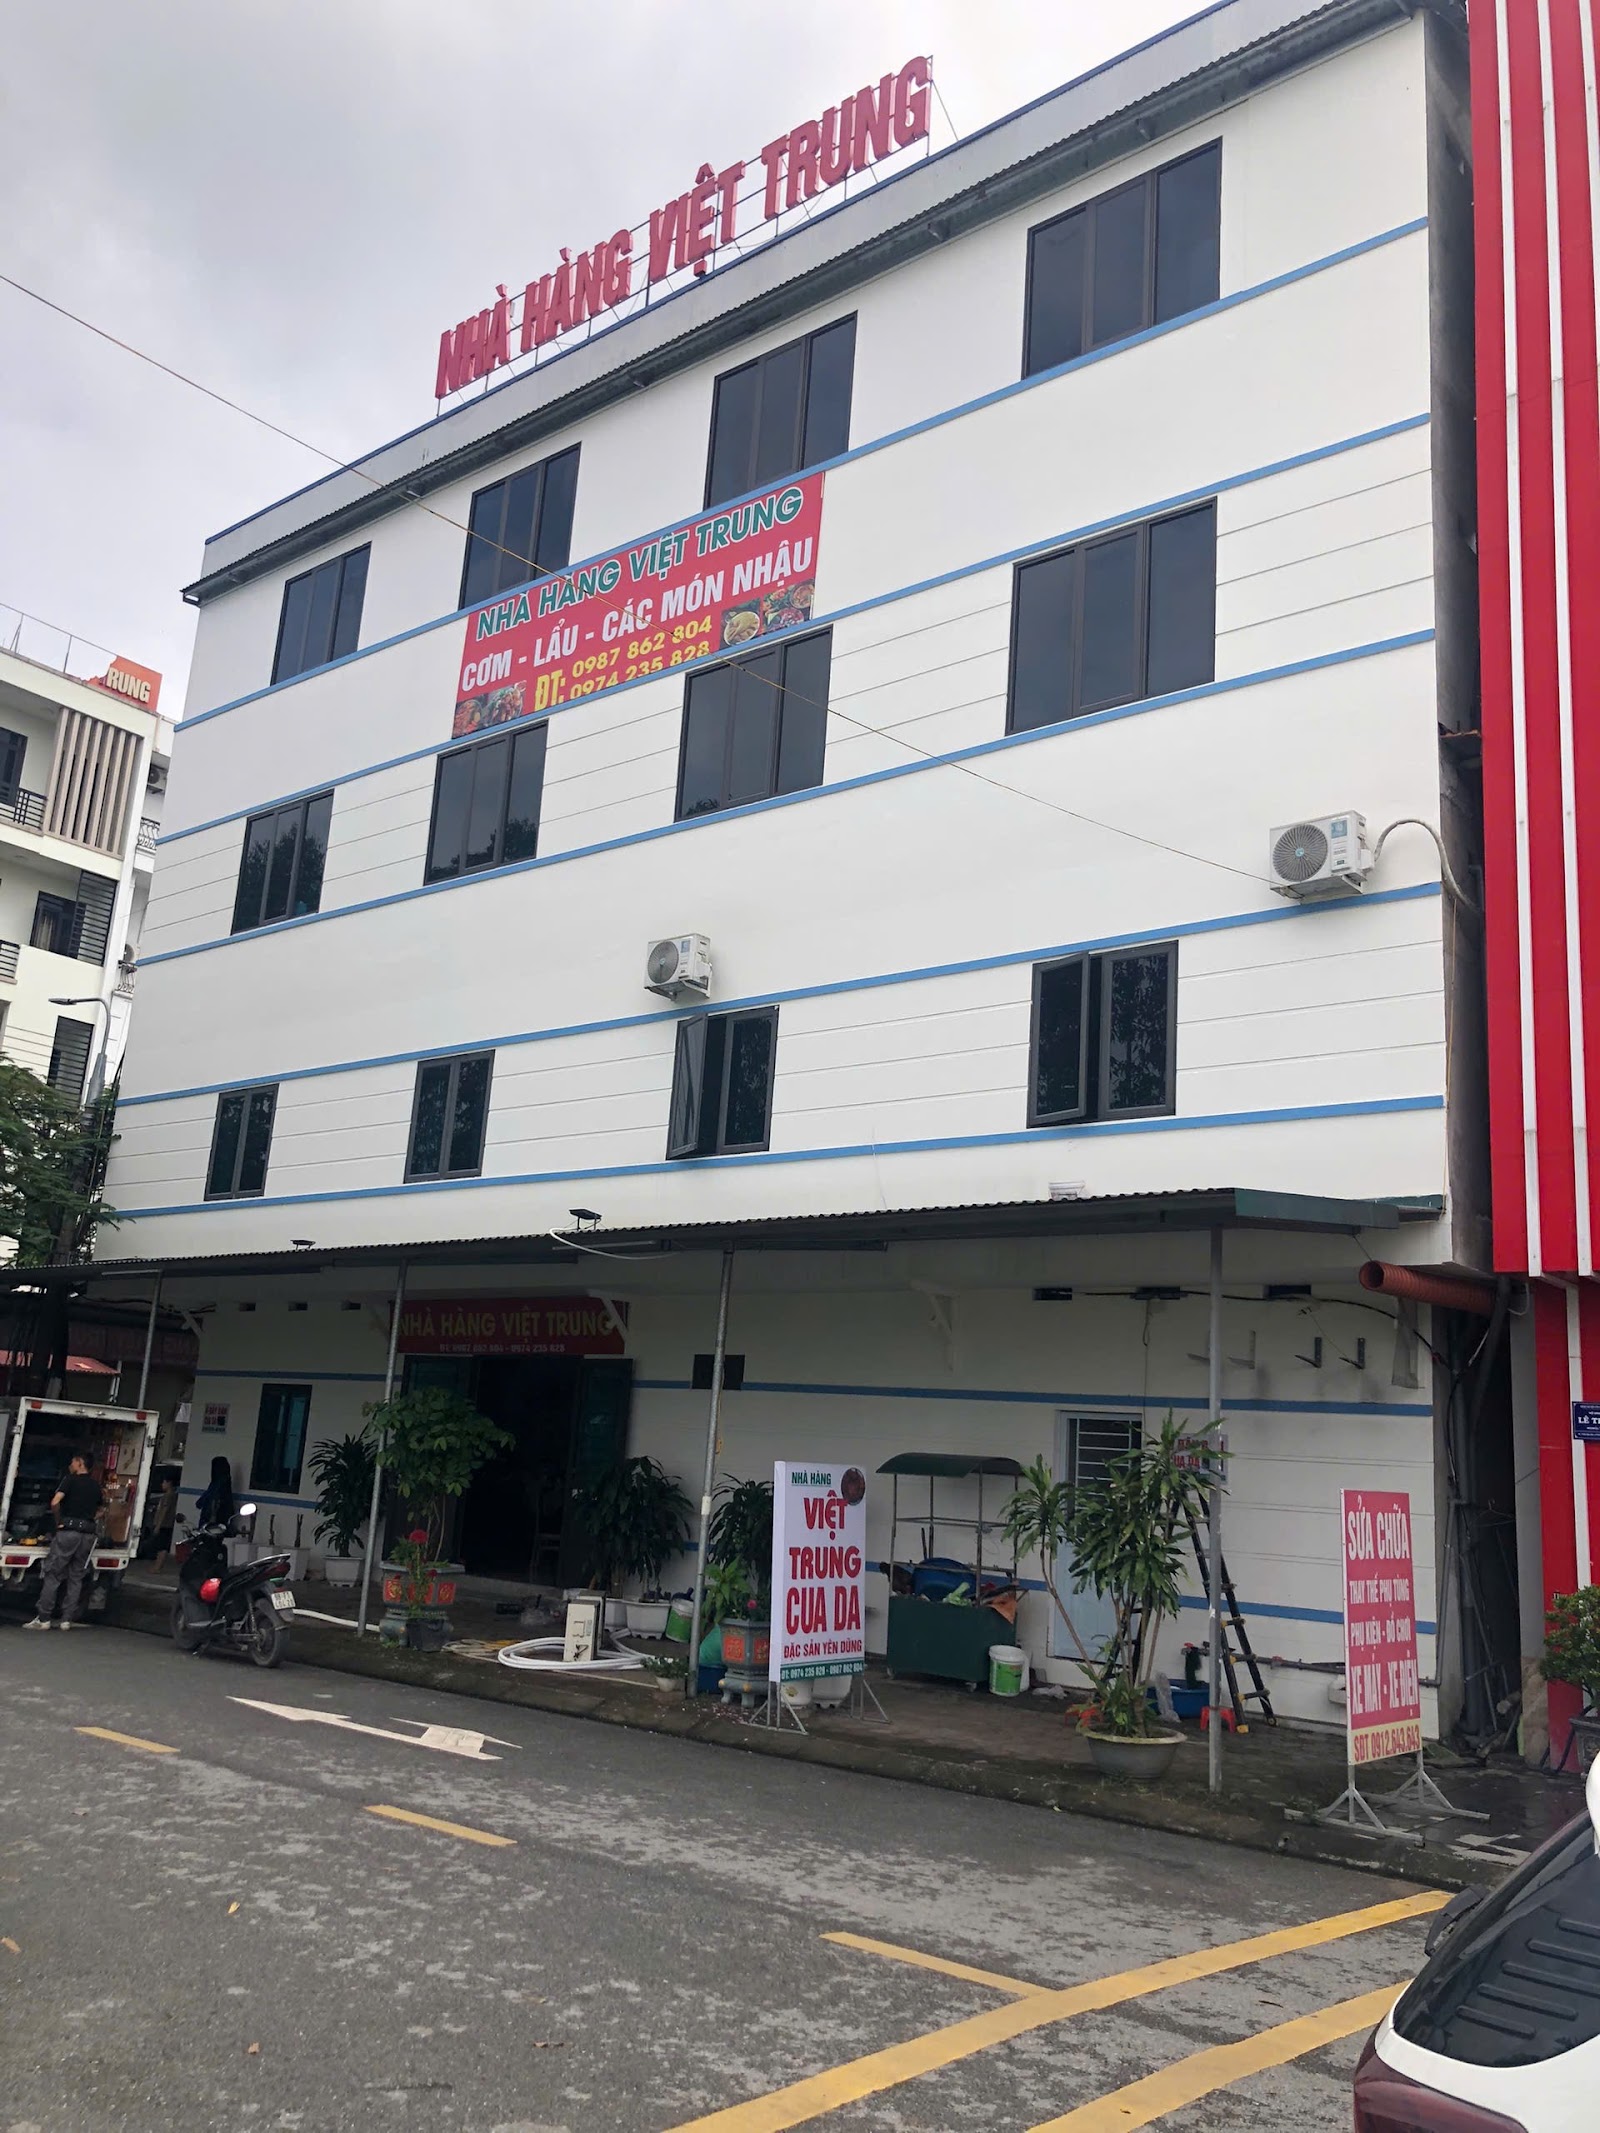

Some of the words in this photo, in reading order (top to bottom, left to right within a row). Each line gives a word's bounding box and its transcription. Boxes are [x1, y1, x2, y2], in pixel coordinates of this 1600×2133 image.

[435, 284, 510, 399] NHÀ
[521, 229, 632, 353] HÀNG
[648, 163, 746, 283] VIỆT
[761, 56, 933, 221] TRUNG
[476, 600, 531, 642] NHÀ
[538, 559, 621, 619] HÀNG
[629, 529, 690, 581] VIỆT
[695, 486, 804, 558] TRUNG
[462, 648, 512, 692] CƠM
[534, 618, 578, 668] LẨU
[602, 598, 653, 643] CÁC
[660, 570, 725, 623] MÓN
[732, 536, 814, 596] NHẬU
[570, 671, 619, 700] 0974
[625, 656, 663, 681] 235
[670, 641, 710, 667] 828
[572, 647, 620, 678] 0987
[627, 632, 665, 659] 862
[671, 615, 712, 643] 804
[440, 1307, 496, 1337] HÀNG
[502, 1305, 541, 1343] VIỆT
[791, 1469, 808, 1485] NHÀ
[810, 1470, 831, 1485] HÀNG
[803, 1489, 849, 1541] VIỆT
[1348, 1494, 1374, 1560] SỬA
[1376, 1503, 1410, 1560] CHỮA
[789, 1545, 861, 1580] TRUNG
[786, 1587, 827, 1635] CUA
[834, 1585, 860, 1631] DA
[784, 1642, 800, 1661] ĐẶC
[803, 1639, 820, 1656] SẢN
[823, 1639, 838, 1655] YÊN
[841, 1638, 862, 1653] DŨNG
[1351, 1665, 1363, 1714] XE
[1363, 1652, 1381, 1713] MÁY
[1388, 1661, 1399, 1709] XE
